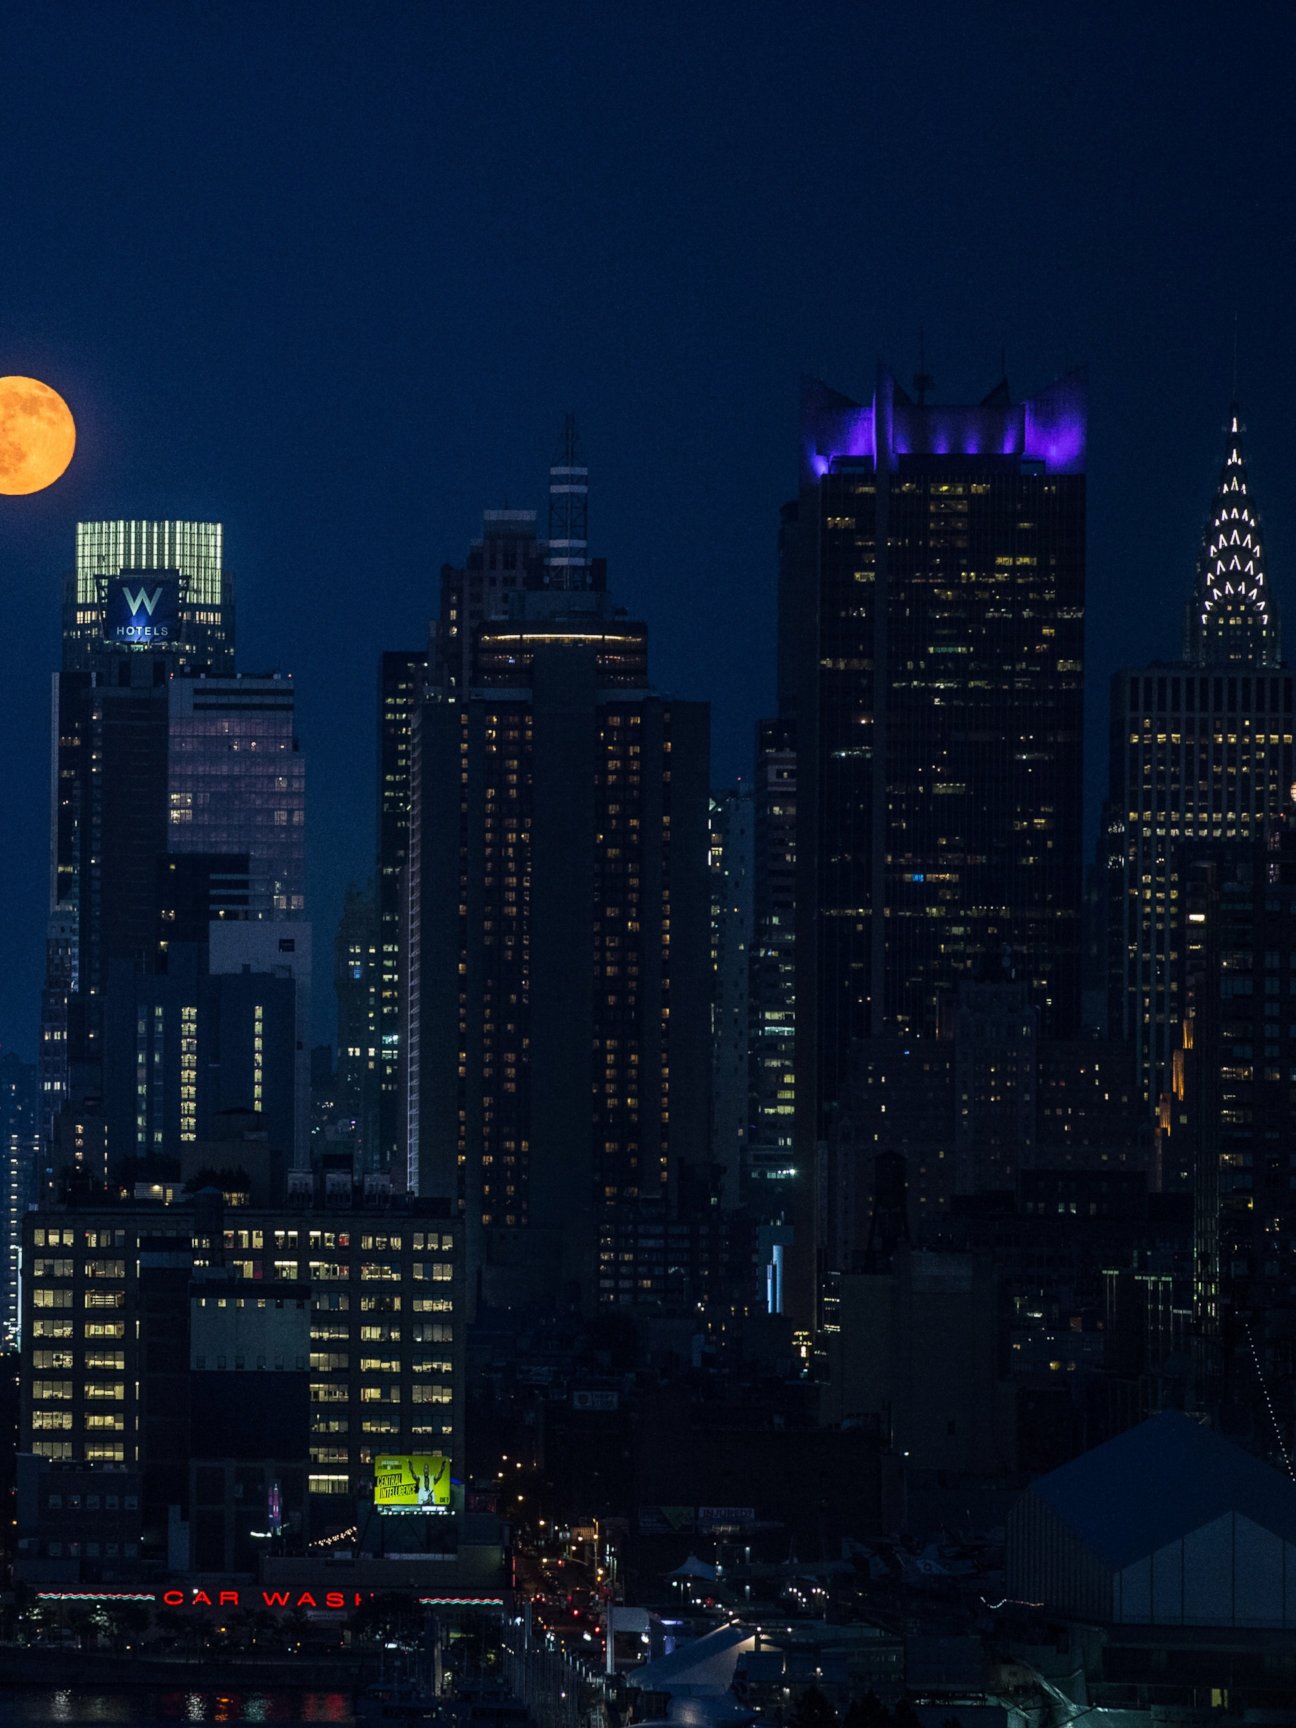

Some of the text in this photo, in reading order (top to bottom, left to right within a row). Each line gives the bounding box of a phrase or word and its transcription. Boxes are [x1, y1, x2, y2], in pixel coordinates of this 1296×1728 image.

[122, 587, 163, 617] W
[116, 626, 168, 636] HOTELS
[376, 1474, 402, 1488] CENTRAL
[380, 1483, 416, 1498] INTELLIGENCE
[163, 1590, 239, 1607] CAR
